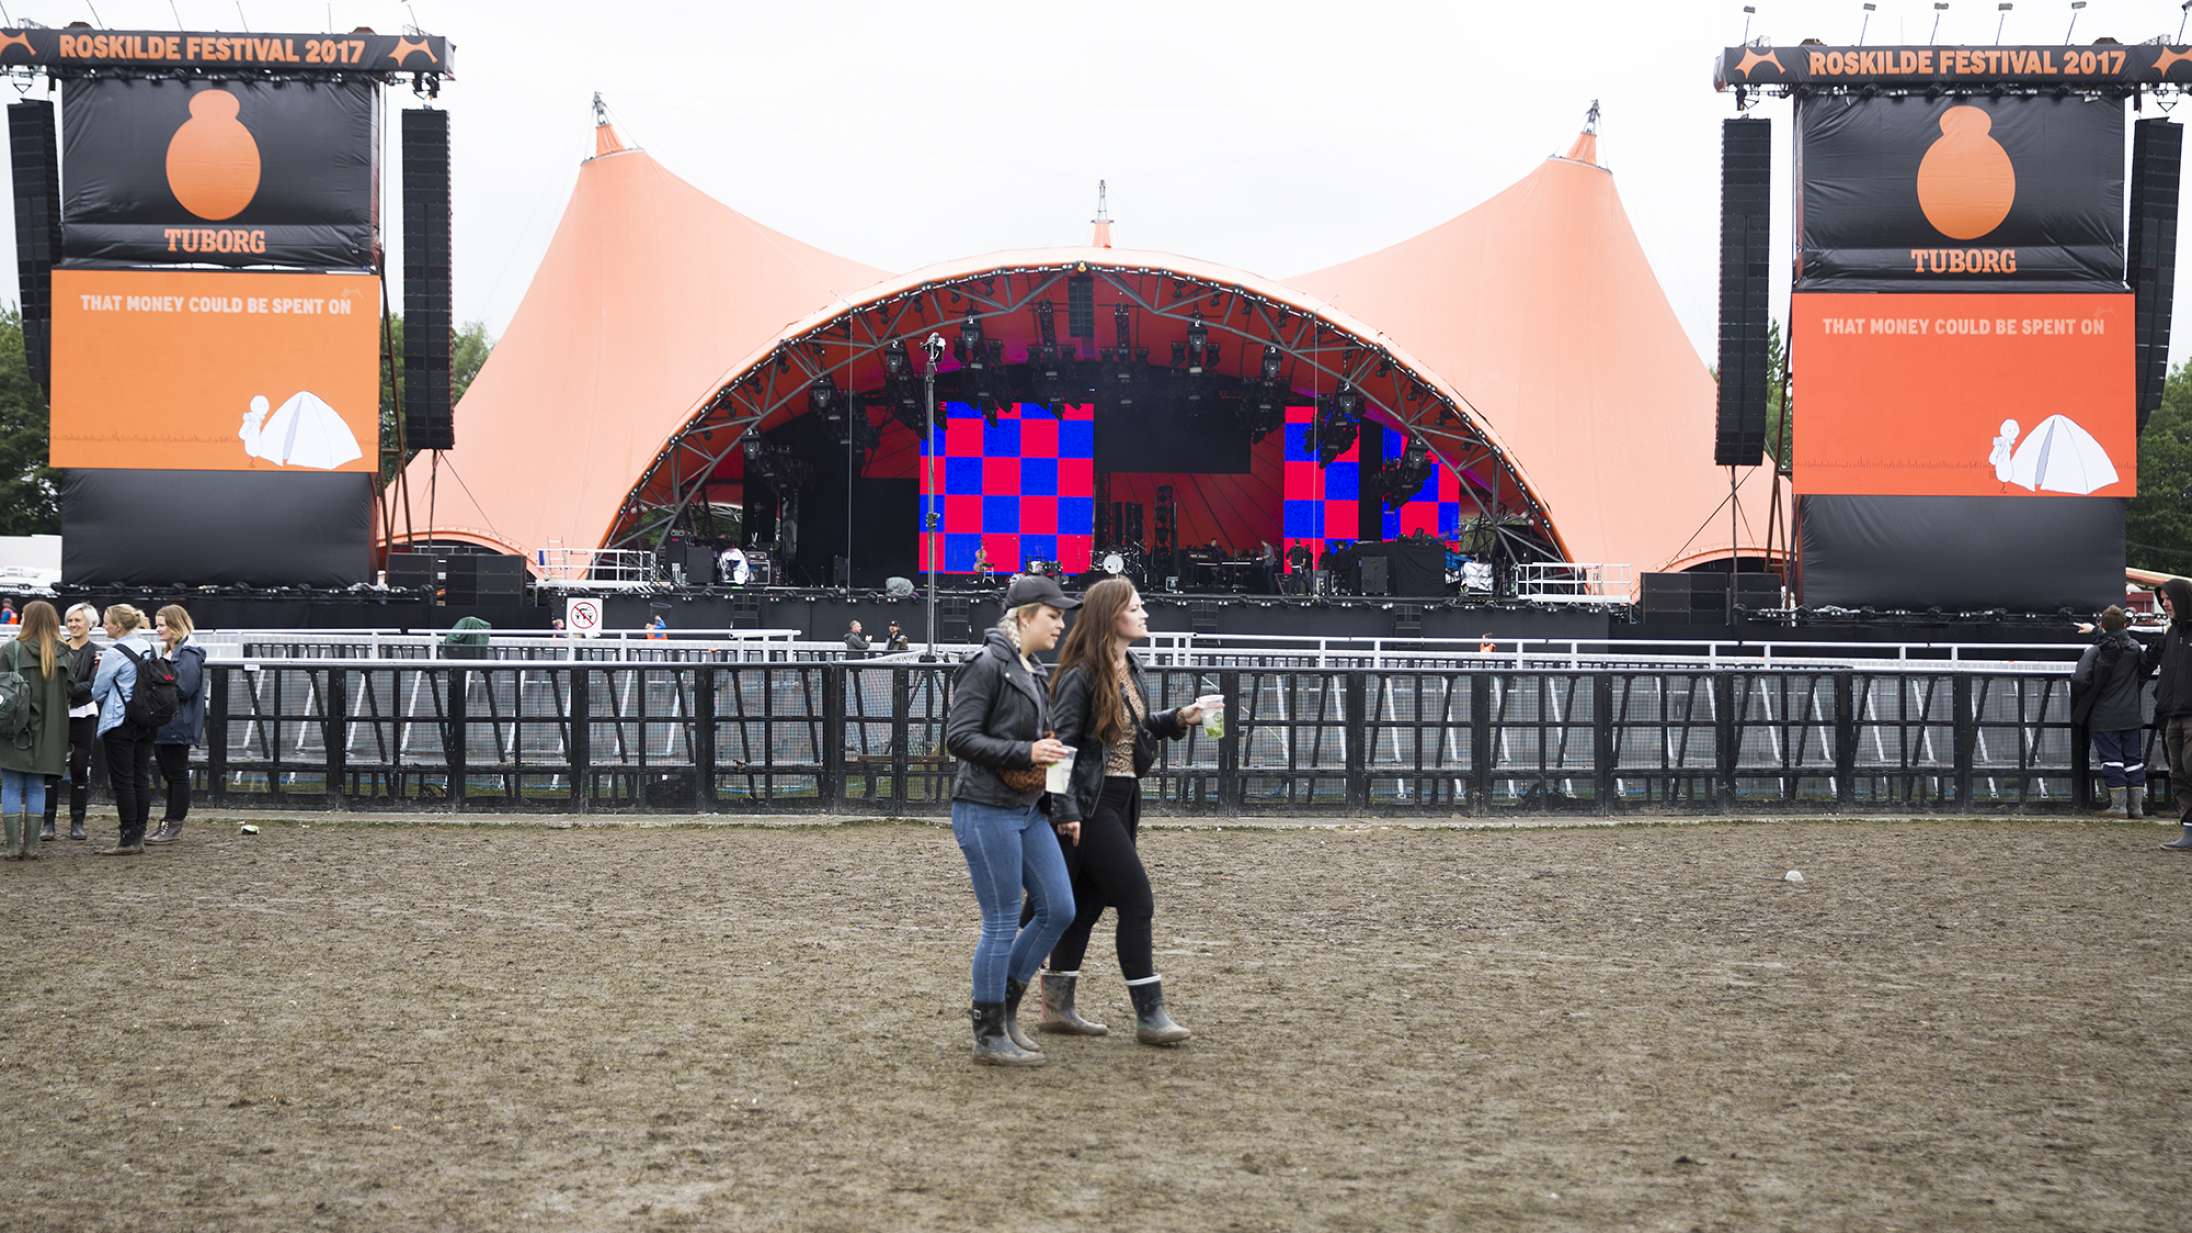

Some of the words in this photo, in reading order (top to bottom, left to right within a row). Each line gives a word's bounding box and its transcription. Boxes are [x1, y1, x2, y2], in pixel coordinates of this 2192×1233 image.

[59, 35, 181, 61] ROSKILDE
[187, 37, 299, 62] FESTIVAL
[305, 40, 365, 64] 2017
[1809, 50, 1933, 76] ROSKILDE
[1939, 50, 2057, 75] FESTIVAL
[2063, 51, 2126, 76] 2017
[165, 229, 266, 254] TUBORG
[1911, 249, 2017, 273] TUBORG
[80, 295, 122, 311] THAT
[127, 296, 184, 312] MONEY
[189, 297, 243, 313] COULD
[248, 297, 269, 313] BE
[272, 298, 325, 315] SPENT
[328, 299, 352, 315] ON
[1822, 318, 1865, 335] THAT
[1870, 318, 1929, 335] MONEY
[1935, 319, 1990, 335] COULD
[1996, 319, 2017, 335] BE
[2022, 319, 2076, 335] SPENT
[2081, 319, 2105, 335] ON
